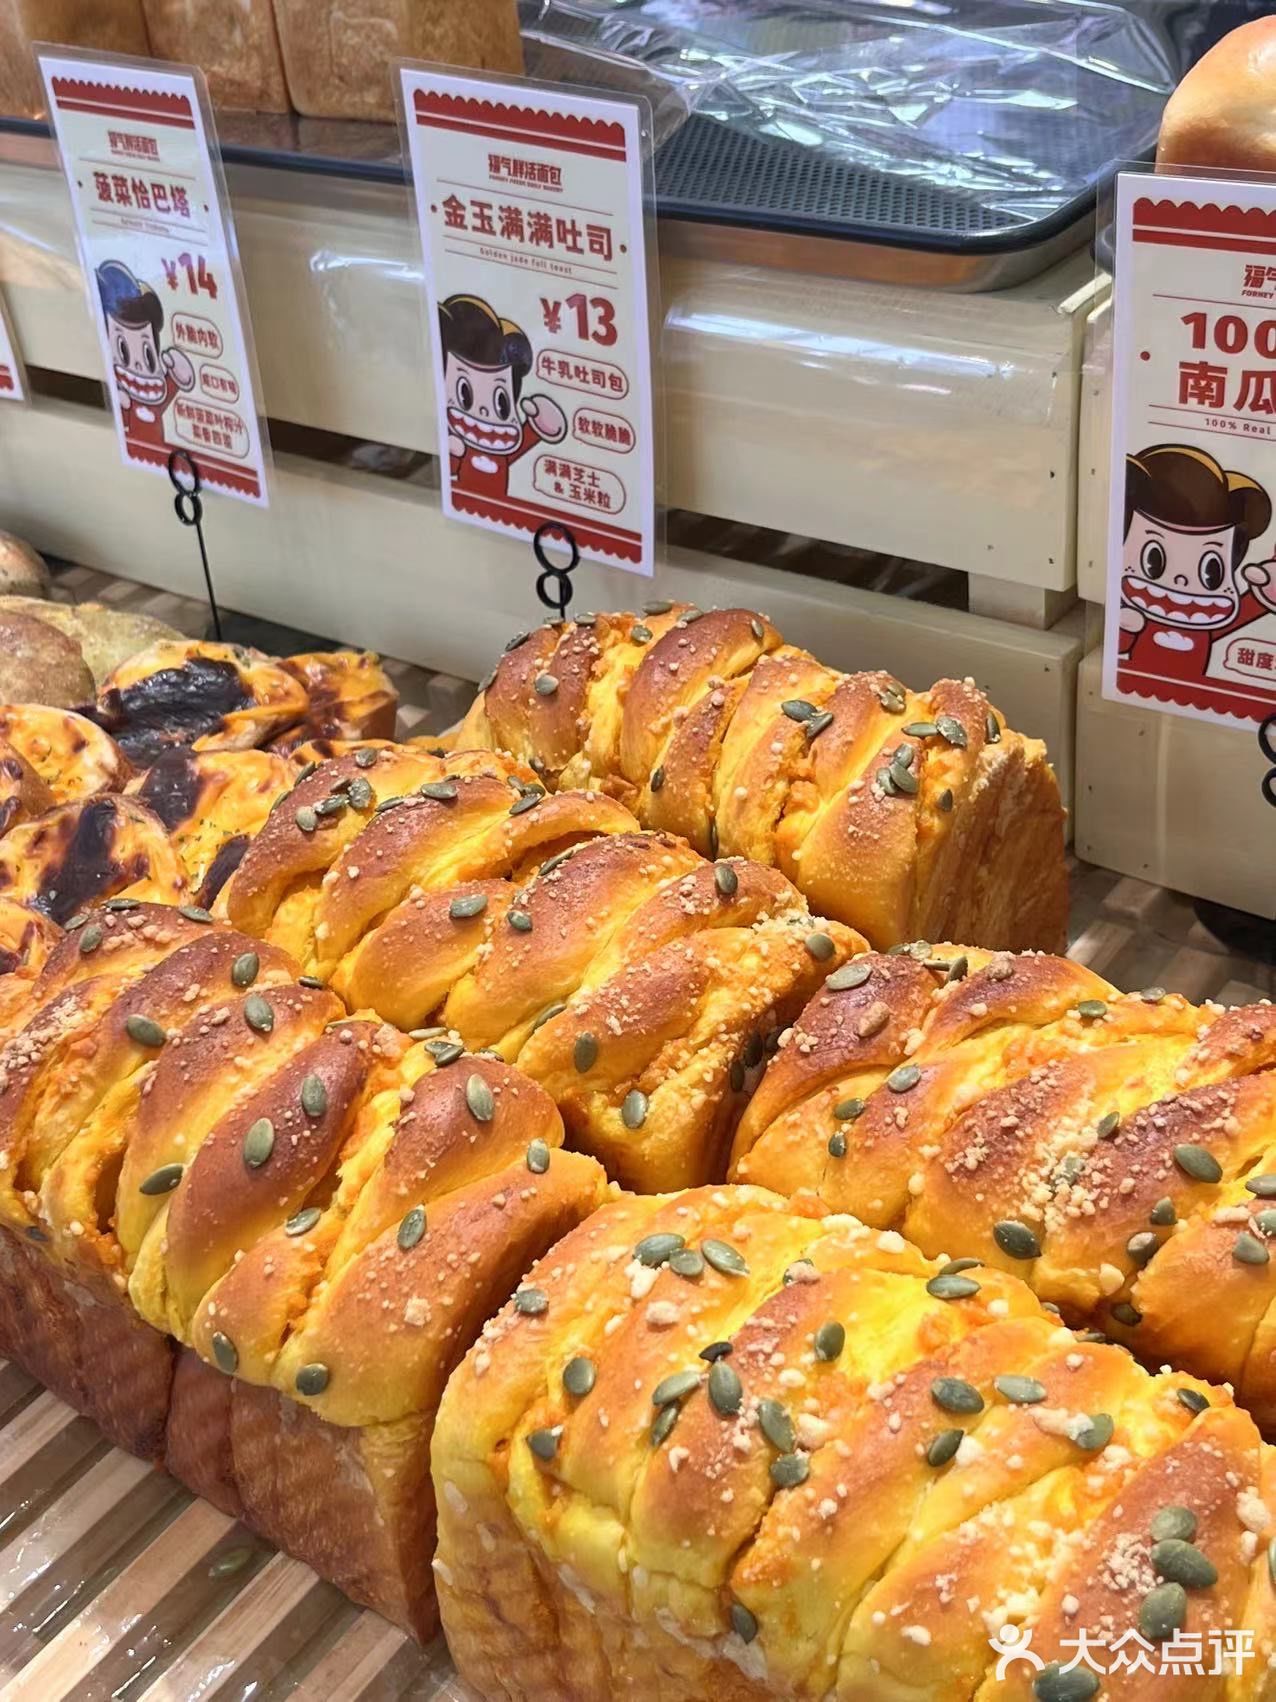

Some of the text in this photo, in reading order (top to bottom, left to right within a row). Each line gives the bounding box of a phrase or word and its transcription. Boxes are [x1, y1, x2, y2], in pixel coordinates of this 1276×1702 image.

[488, 154, 562, 185] 福气鲜活面包
[93, 171, 190, 218] 菠菜恰巴塔
[442, 194, 612, 262] 金玉满满吐司
[161, 252, 218, 301] ¥14
[540, 293, 618, 346] ¥13
[541, 356, 624, 393] 牛乳吐司包
[1178, 361, 1276, 415] 南瓜
[577, 416, 632, 446] 软软脆脆
[1204, 418, 1271, 435] 100% Real
[543, 459, 600, 488] 满满芝士
[569, 484, 611, 509] 玉米粒
[1237, 647, 1276, 671] 甜度
